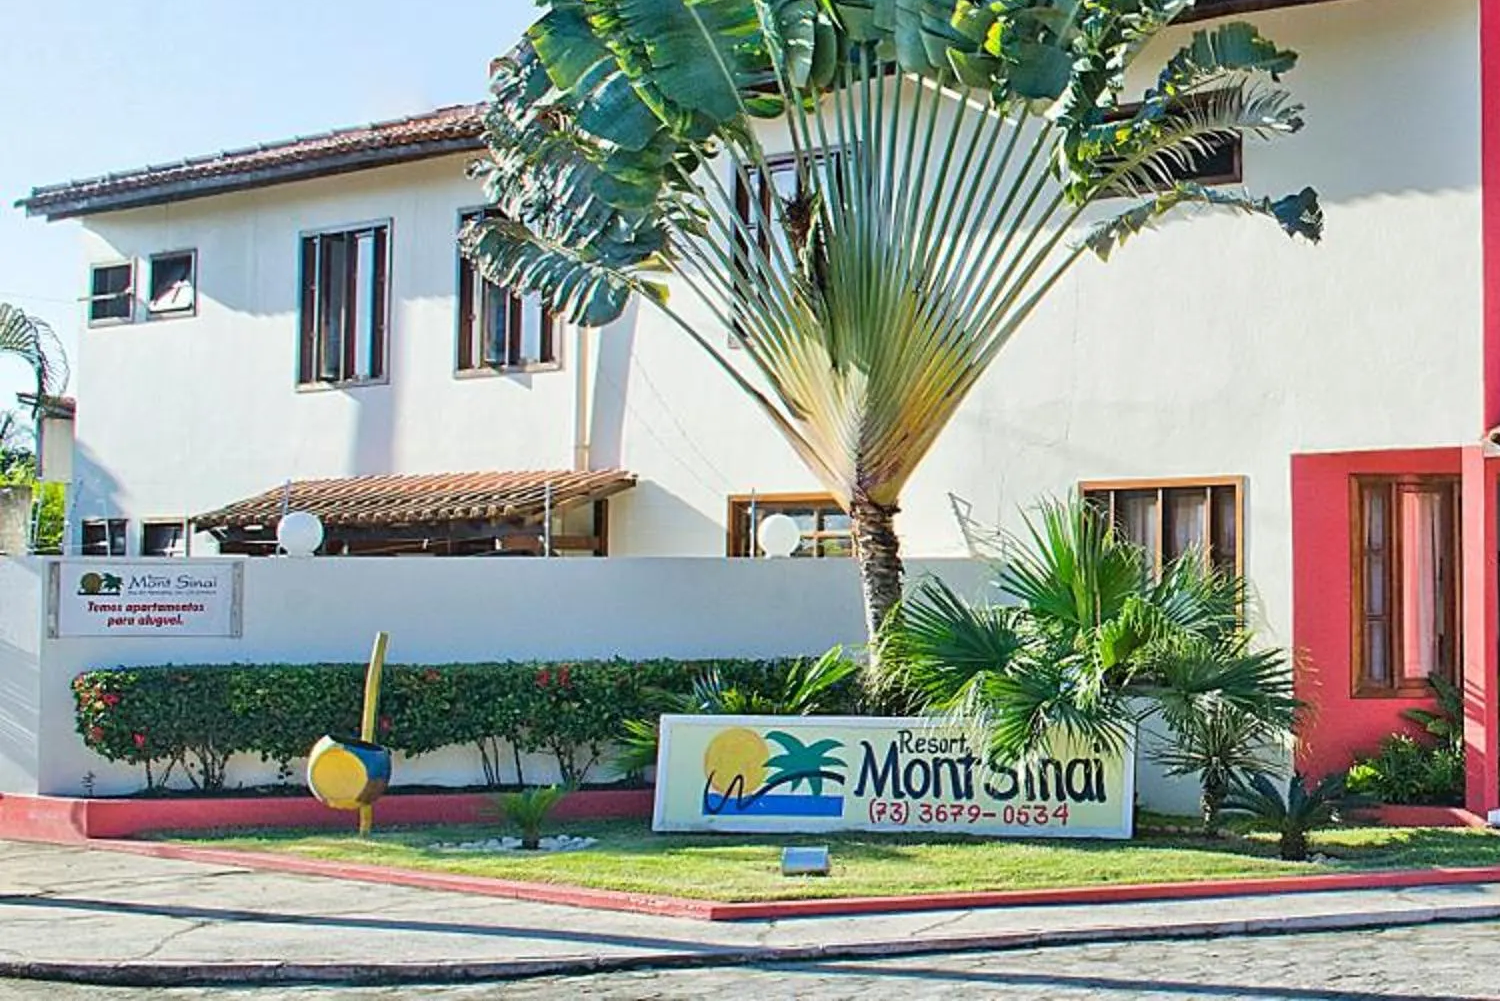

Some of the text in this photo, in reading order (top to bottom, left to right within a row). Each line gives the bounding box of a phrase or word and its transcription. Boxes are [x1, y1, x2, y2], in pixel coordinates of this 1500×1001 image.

[128, 574, 217, 589] Mont Sinai
[87, 601, 205, 615] Temos apartamentos
[107, 615, 135, 627] para
[869, 800, 909, 824] (73)
